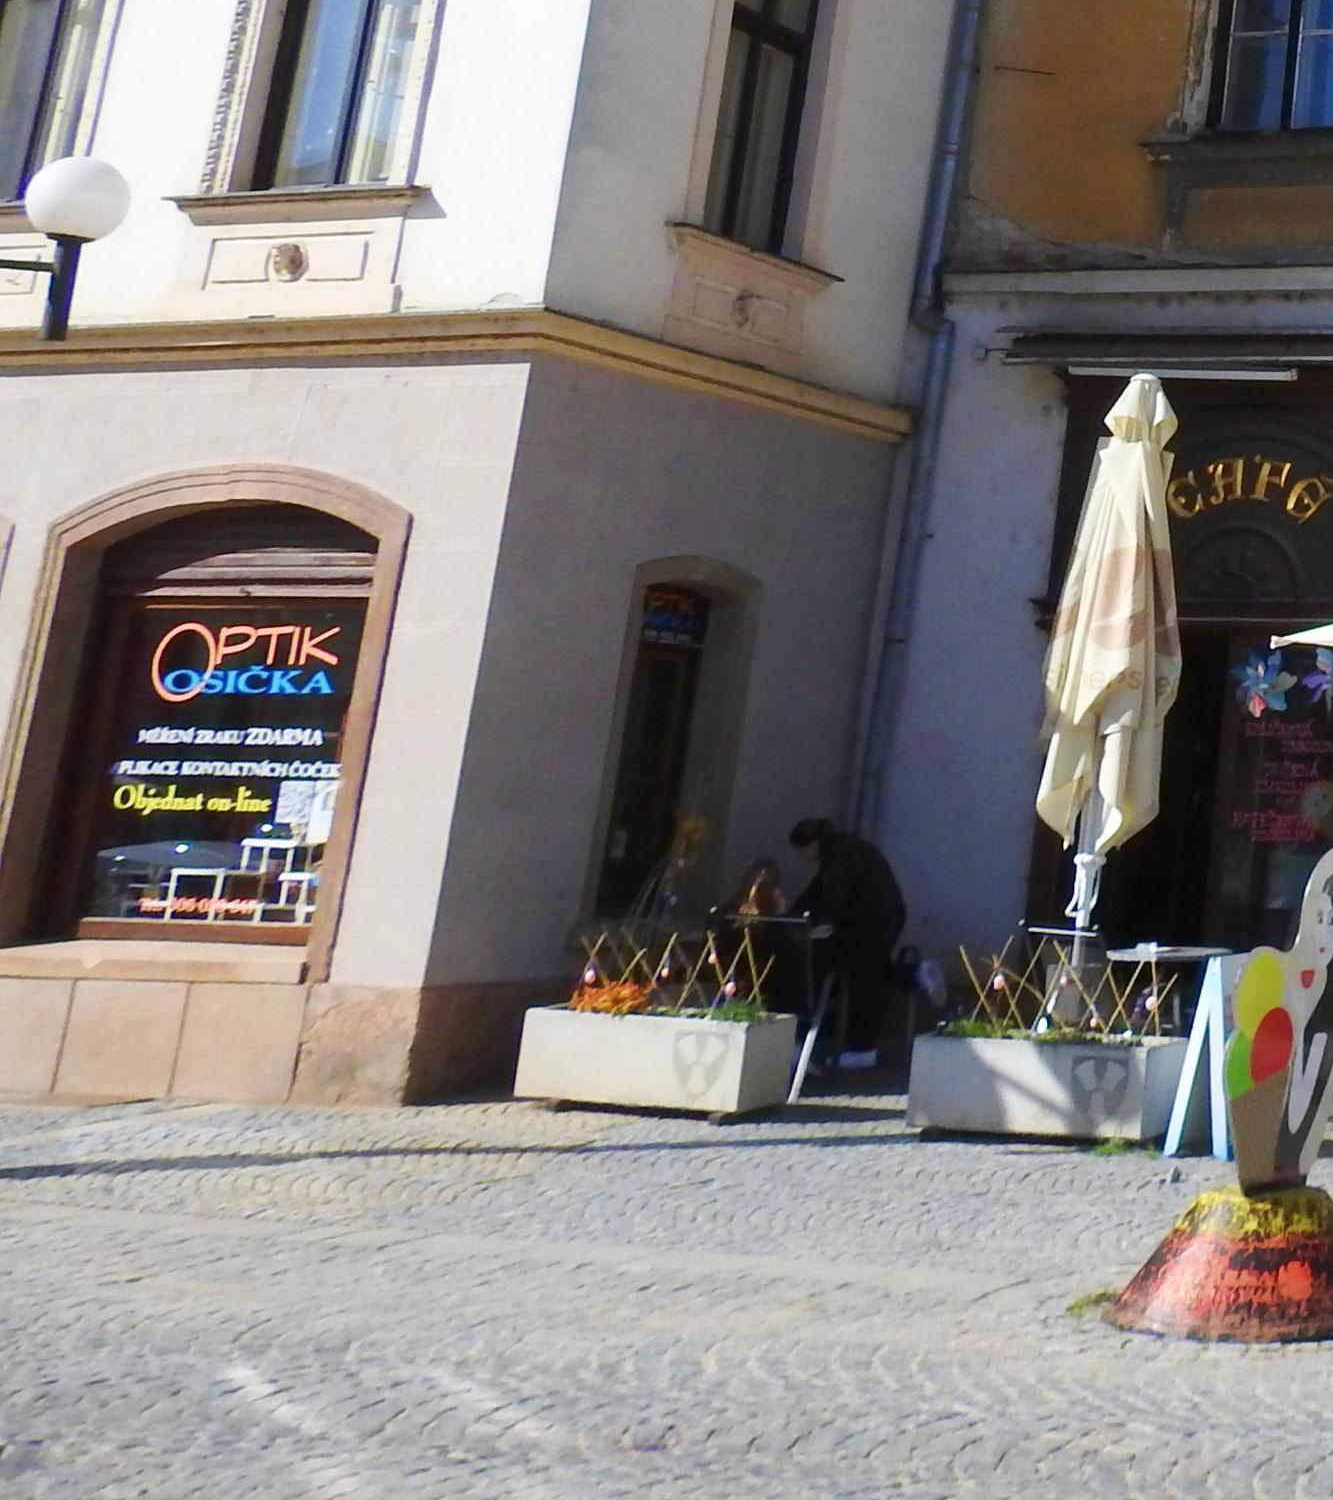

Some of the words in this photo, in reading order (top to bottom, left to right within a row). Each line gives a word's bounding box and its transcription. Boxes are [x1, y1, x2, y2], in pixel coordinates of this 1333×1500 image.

[151, 622, 342, 703] OPTIK
[163, 665, 334, 695] OSIČKA
[194, 729, 244, 745] ZRAKU
[244, 727, 324, 746] ZDARMA
[113, 784, 204, 816] Objednat
[206, 784, 273, 813] on-line
